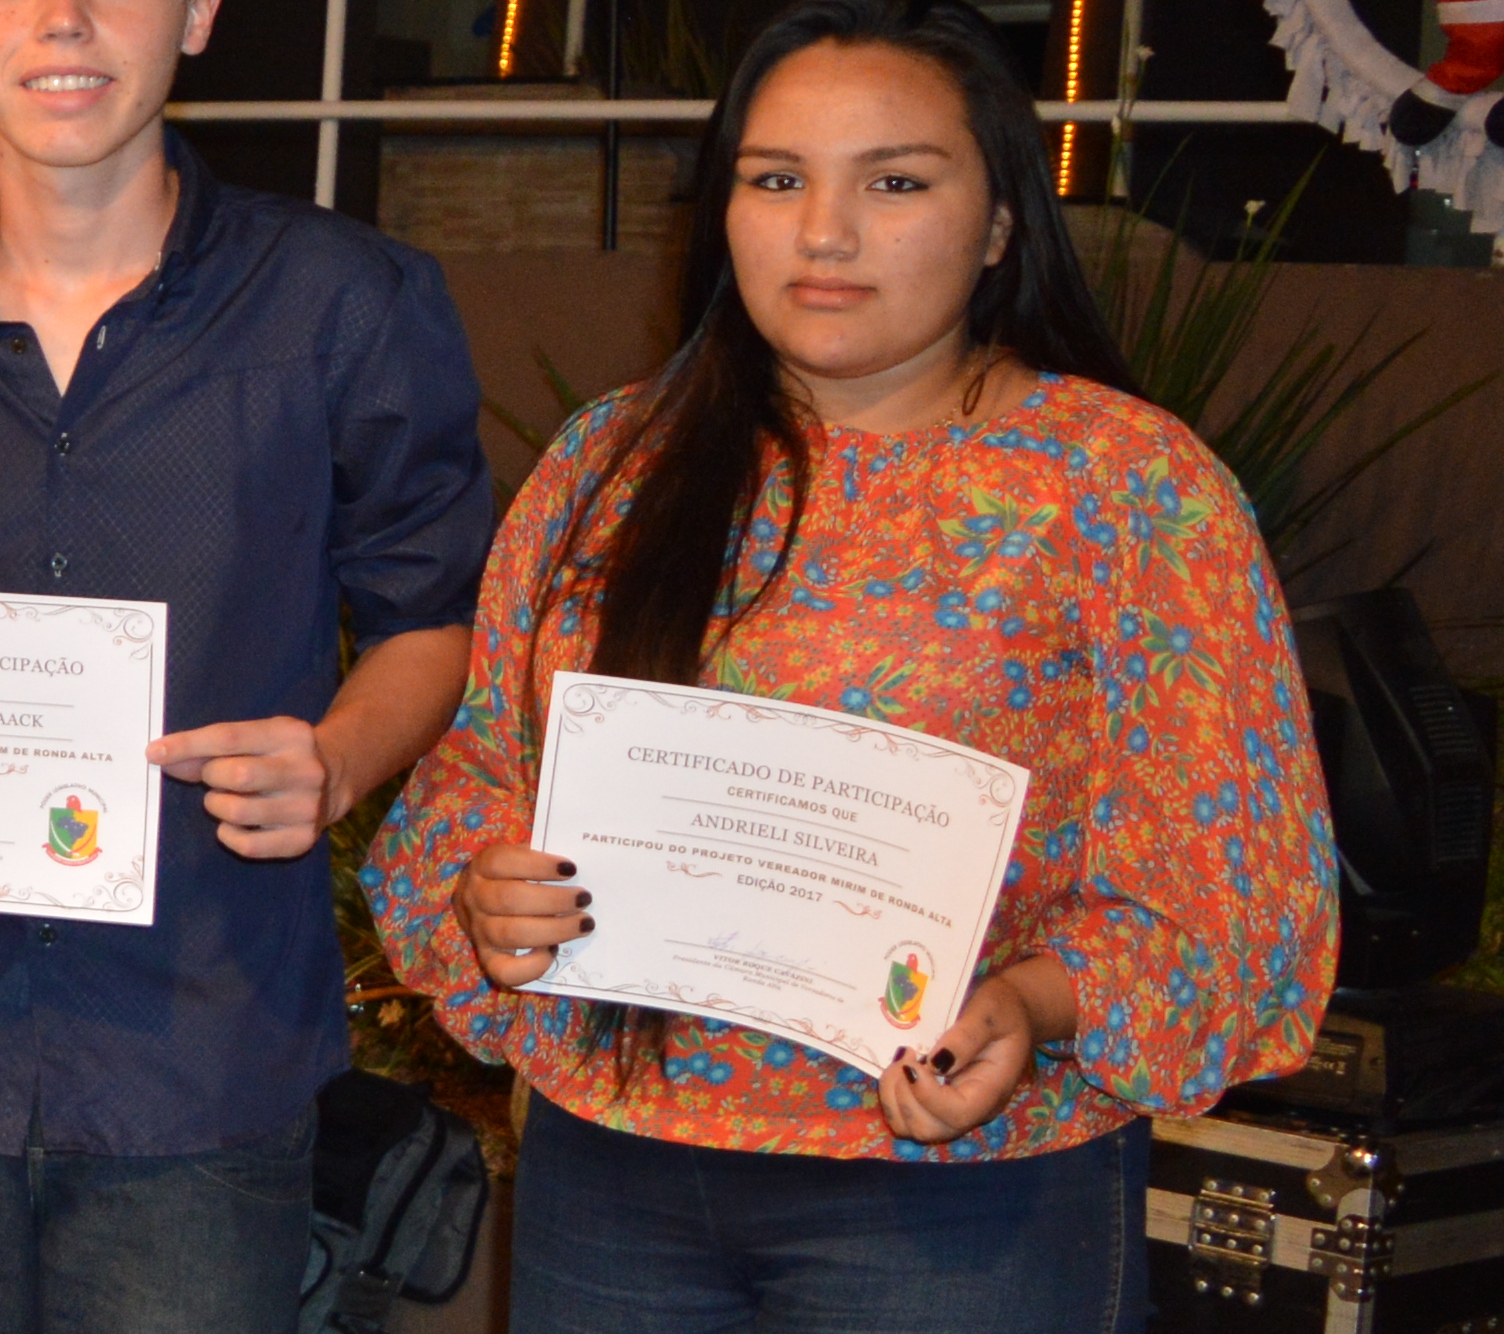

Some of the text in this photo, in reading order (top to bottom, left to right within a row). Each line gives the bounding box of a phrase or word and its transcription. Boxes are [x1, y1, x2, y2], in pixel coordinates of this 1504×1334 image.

[13, 747, 29, 756] DE
[33, 748, 76, 759] RONDA
[81, 752, 113, 762] ALTA
[627, 746, 950, 828] CERTIFICADO DE PARTICIPAÇÃO
[726, 785, 858, 823] CERTIFICAMOS QUE
[691, 813, 878, 867] ANDRIELI SILVEIRA
[582, 832, 952, 928] PARTICIPOU DO PROJETO VEREADOR MIRIM DE RONDA ALTA
[736, 874, 824, 903] EDIÇÃO 2017
